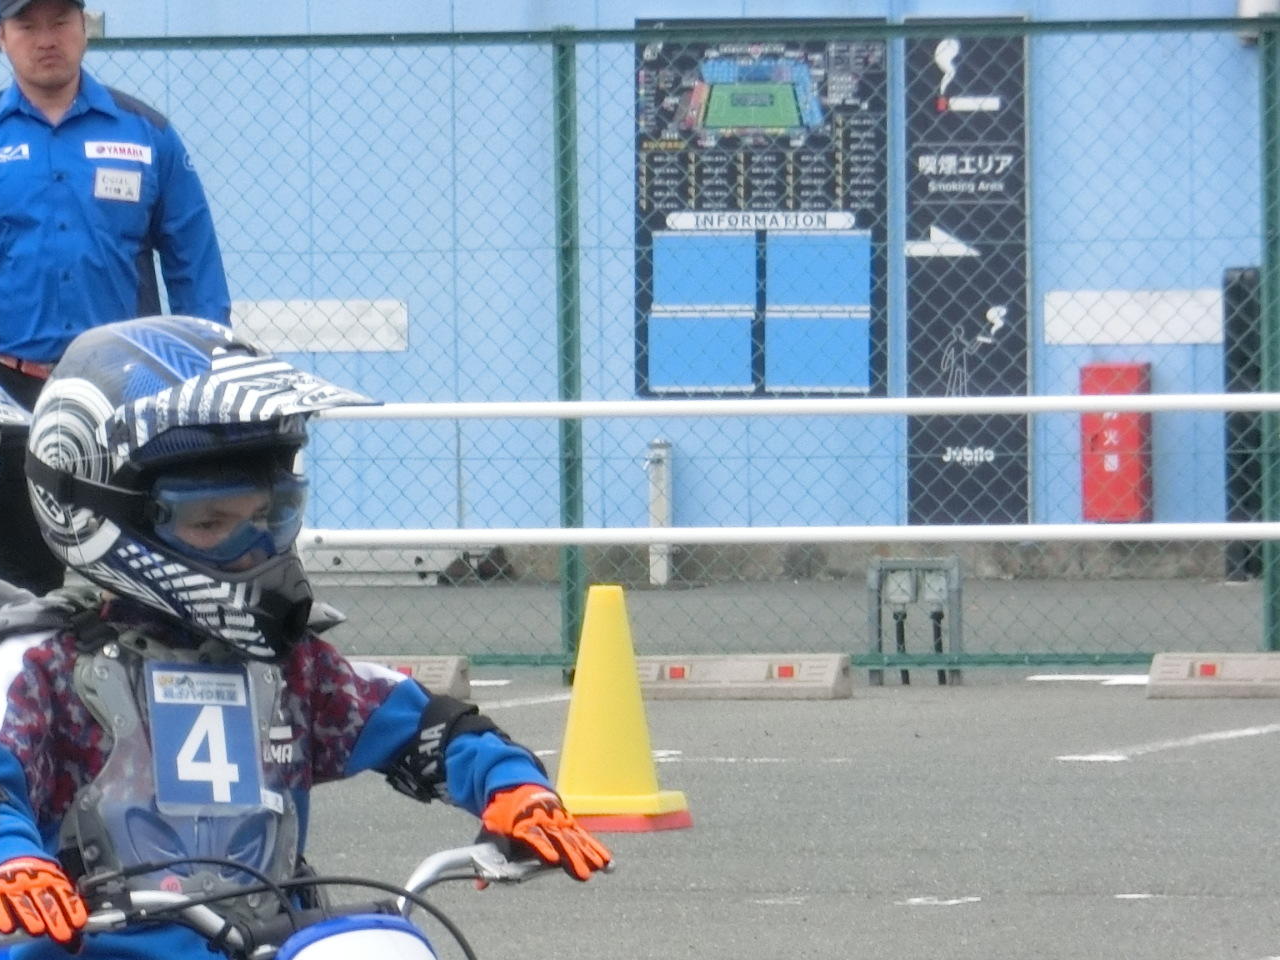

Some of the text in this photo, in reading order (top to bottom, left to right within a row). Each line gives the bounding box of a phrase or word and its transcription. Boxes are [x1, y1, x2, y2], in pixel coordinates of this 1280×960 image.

[106, 144, 144, 158] YAMAHA
[918, 154, 1014, 175] 喫煙エリア
[927, 180, 1004, 193] Smoking Area
[694, 213, 828, 229] INFORMATION
[176, 704, 240, 803] 4
[262, 743, 293, 764] UMA
